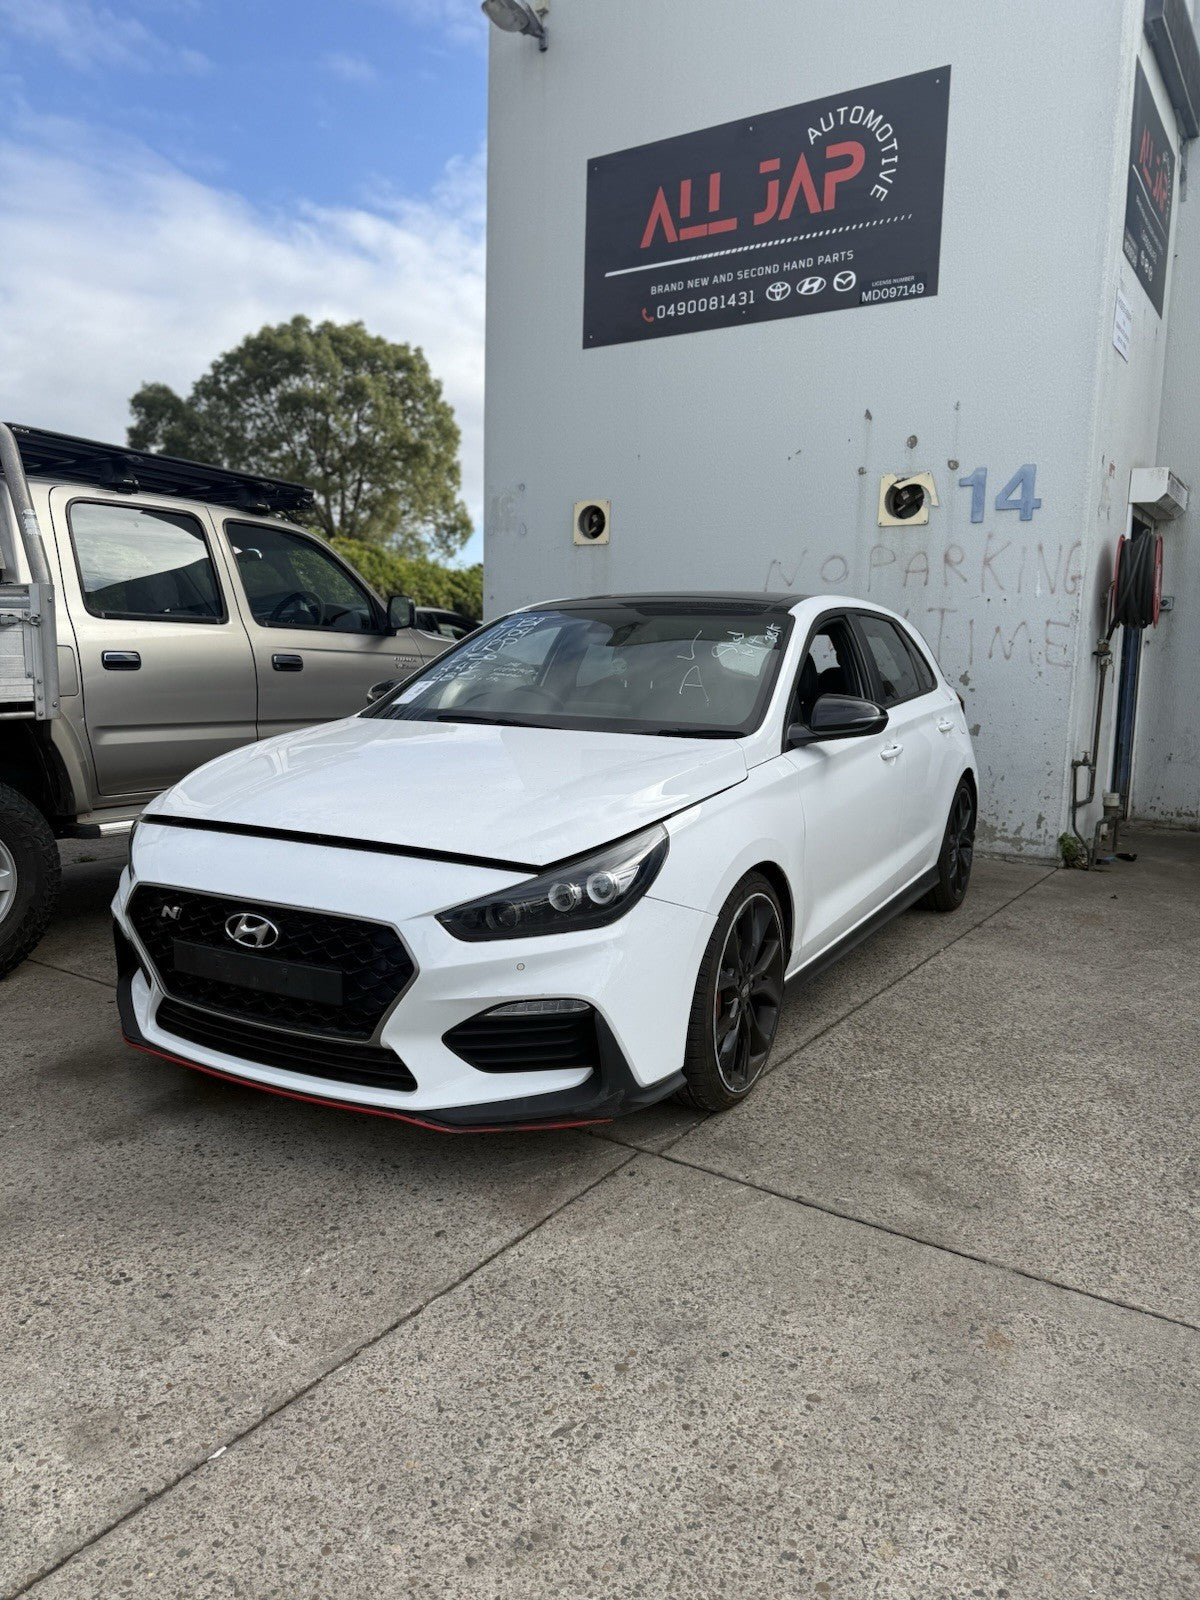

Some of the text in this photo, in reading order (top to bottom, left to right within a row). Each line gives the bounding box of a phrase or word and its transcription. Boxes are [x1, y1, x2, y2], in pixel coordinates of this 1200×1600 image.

[807, 105, 898, 202] AUTOMOTIVE
[640, 140, 866, 249] ALL JAP
[650, 250, 854, 296] BRAND NEW AND SECOND HAND PARTS
[893, 275, 915, 284] NUMBER
[656, 290, 755, 319] 0490081431
[958, 463, 1042, 523] 14
[764, 532, 1082, 595] NO PARKING
[161, 905, 182, 920] N
